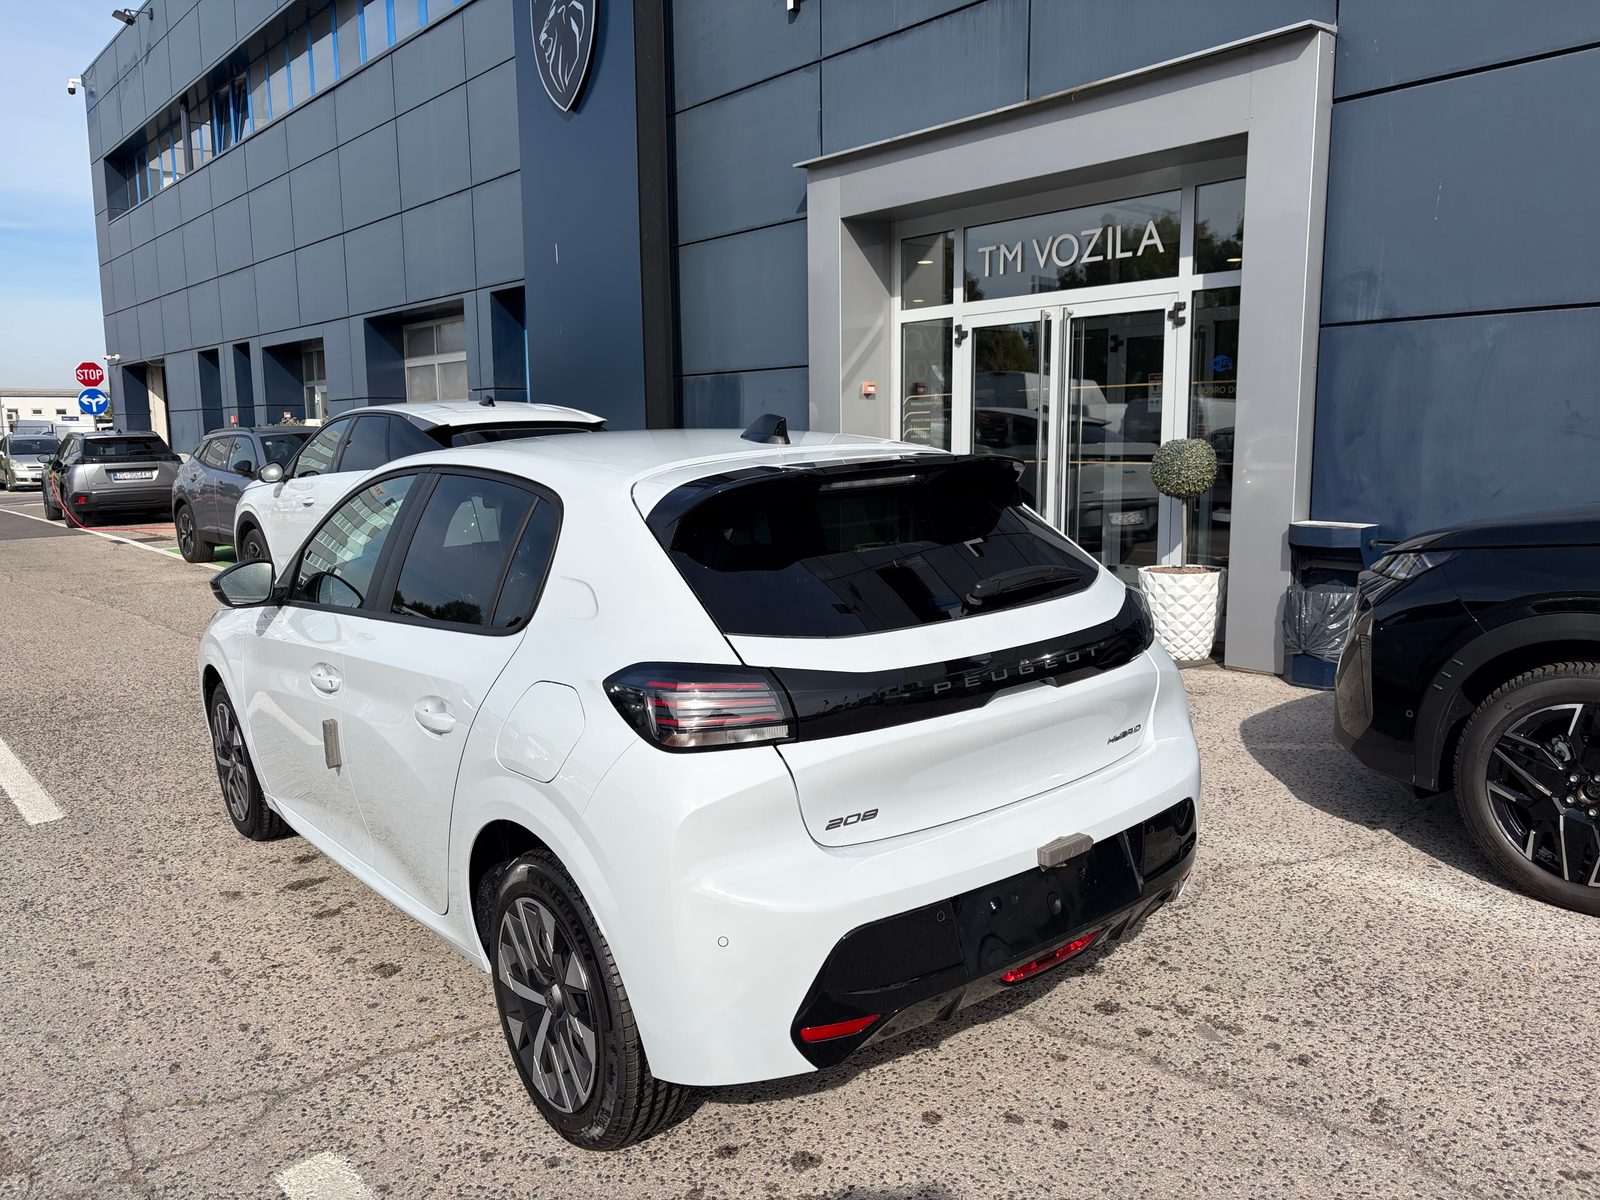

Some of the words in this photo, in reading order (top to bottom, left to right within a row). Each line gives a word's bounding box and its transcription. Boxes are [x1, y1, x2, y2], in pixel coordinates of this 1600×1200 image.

[977, 240, 1024, 278] TM
[1032, 219, 1165, 270] VOZILA
[76, 369, 103, 381] STOP
[933, 646, 1099, 695] PEUGEOT
[1106, 723, 1142, 746] HYBRID
[825, 808, 879, 831] 208
